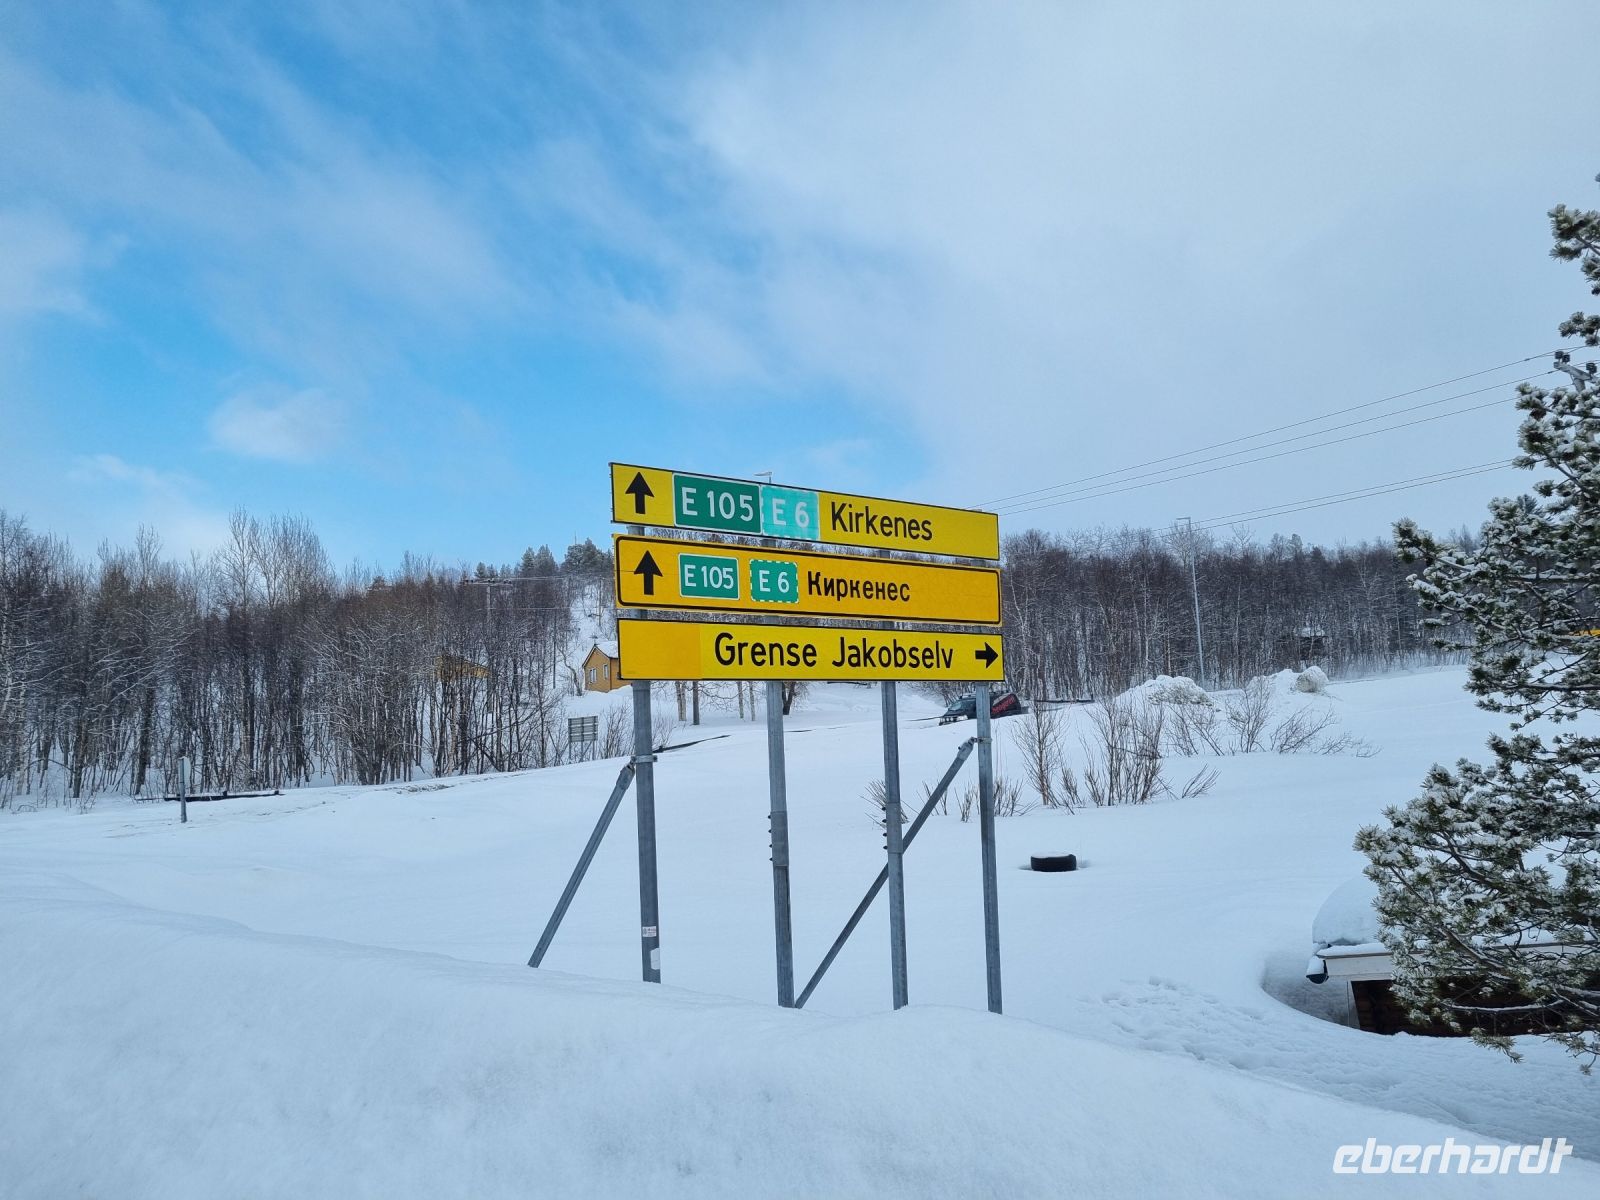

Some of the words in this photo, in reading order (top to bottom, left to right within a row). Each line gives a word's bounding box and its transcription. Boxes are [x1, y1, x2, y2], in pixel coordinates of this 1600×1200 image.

[681, 487, 698, 516] E
[706, 490, 754, 522] 105
[772, 498, 787, 526] E
[795, 501, 810, 528] 6
[831, 501, 933, 541] Kirkenes
[758, 570, 770, 592] E
[777, 571, 790, 593] 6
[808, 571, 910, 602] Киркенес
[714, 632, 817, 667] Grense
[832, 636, 954, 669] Jakobselv
